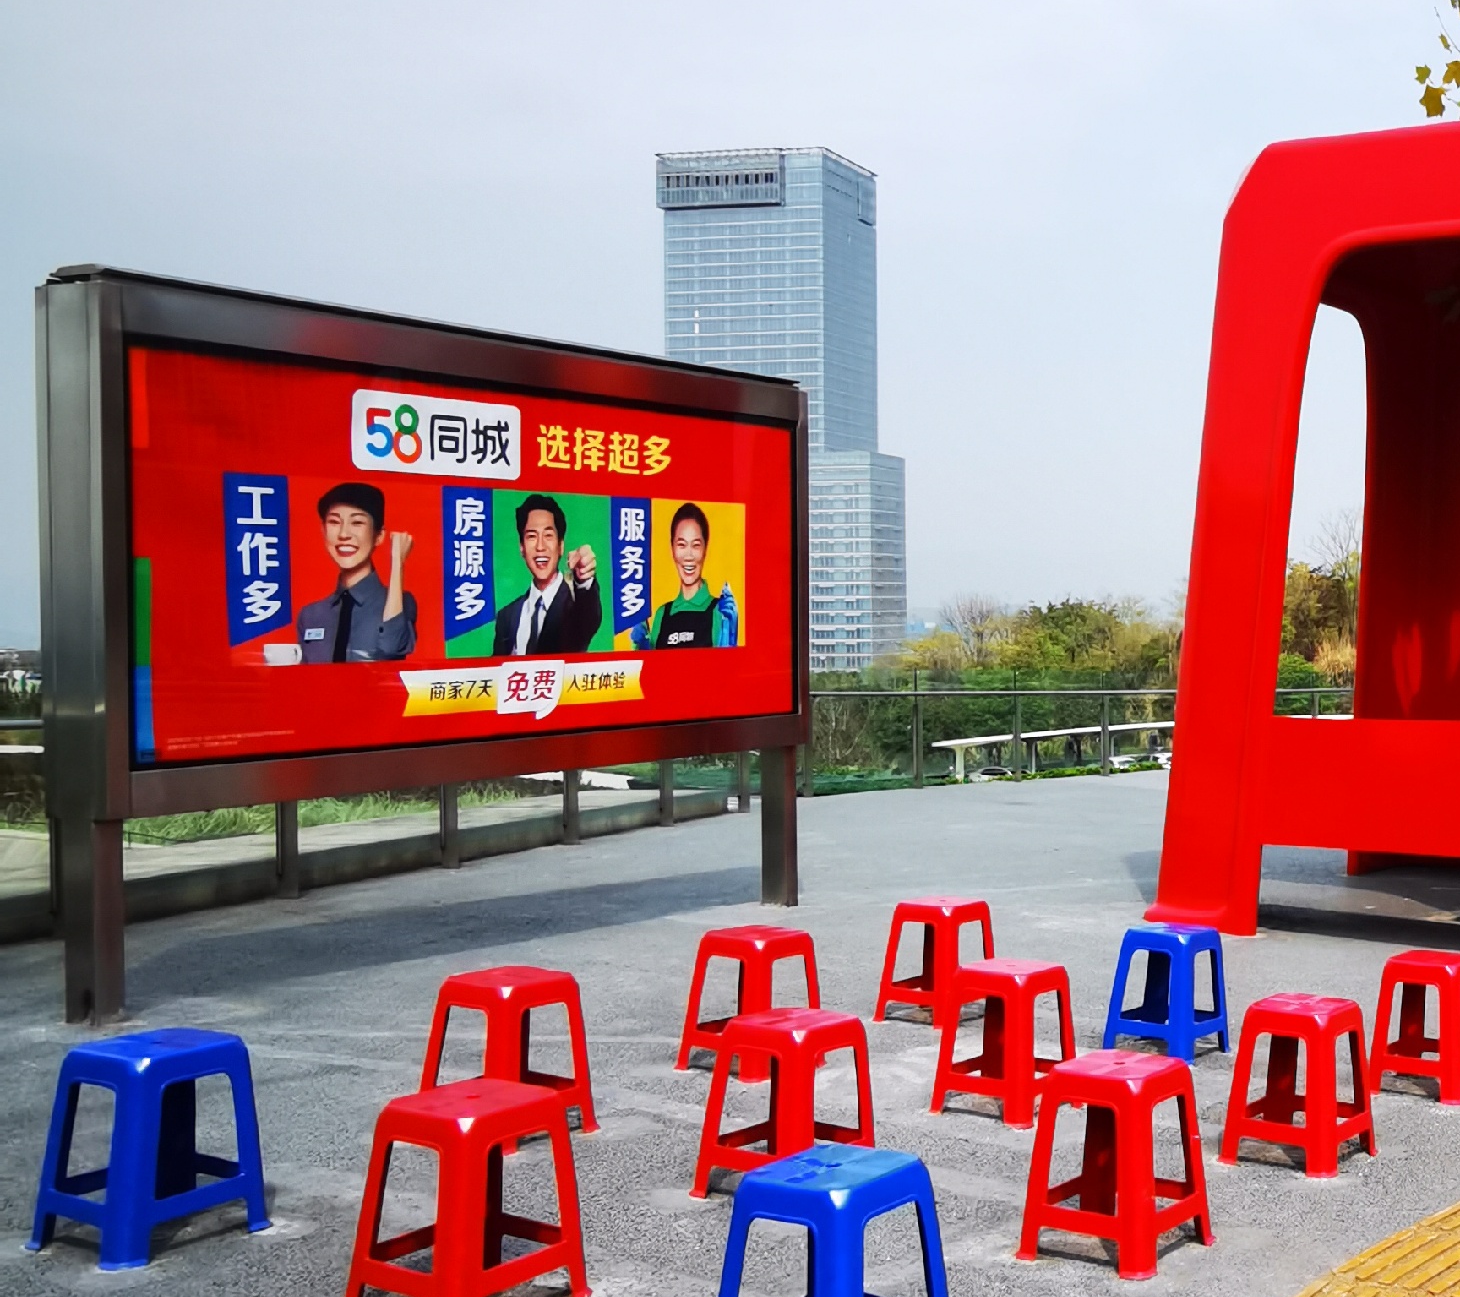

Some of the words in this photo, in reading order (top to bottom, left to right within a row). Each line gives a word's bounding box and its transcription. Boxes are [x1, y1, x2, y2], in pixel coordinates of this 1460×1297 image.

[366, 404, 510, 466] 58同城
[537, 424, 672, 476] 选择超多
[236, 485, 281, 624] 工作多
[453, 497, 486, 620] 房源多
[618, 508, 645, 618] 服务多
[429, 679, 493, 701] 商家7天
[504, 670, 556, 703] 免费
